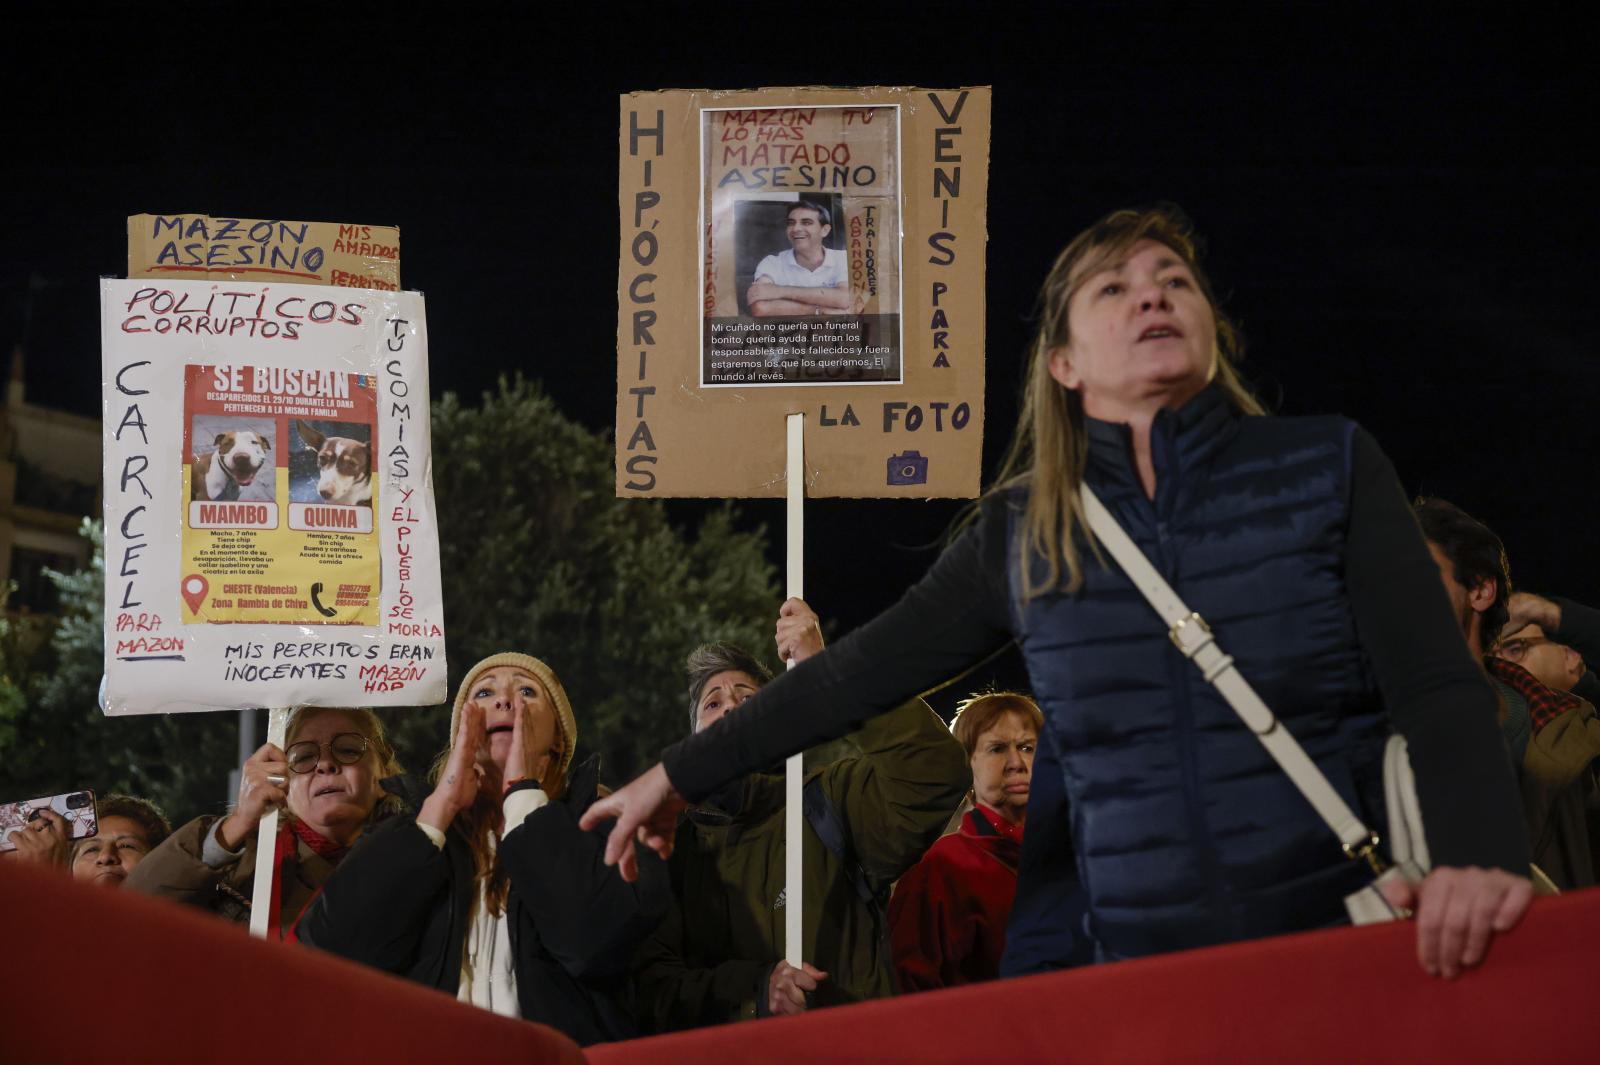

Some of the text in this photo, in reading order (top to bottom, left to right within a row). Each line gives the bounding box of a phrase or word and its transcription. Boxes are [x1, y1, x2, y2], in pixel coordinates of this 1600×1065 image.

[721, 126, 805, 142] LO HAS
[723, 143, 850, 166] MATADO
[717, 165, 876, 189] ASESINO
[928, 91, 969, 265] VENIS
[338, 224, 371, 241] MIS
[333, 239, 399, 259] AMADOS
[625, 110, 664, 491] HIPÓCRITAS
[121, 315, 304, 340] CORRUPTOS
[711, 323, 723, 332] Mi
[725, 323, 760, 332] cuñado
[778, 321, 808, 333] quería
[810, 323, 823, 331] un
[825, 321, 859, 330] funeral
[931, 282, 950, 367] PARA
[711, 335, 744, 345] bonito,
[746, 335, 776, 346] quería
[812, 333, 844, 342] Entran
[846, 333, 860, 342] los
[711, 345, 890, 359] responsables de los fallecidos y fuera
[711, 360, 762, 369] estaremos
[764, 359, 779, 368] los
[780, 359, 799, 369] que
[801, 358, 816, 367] los
[874, 357, 884, 366] El
[213, 364, 244, 393] SE
[252, 366, 350, 399] BUSCAN
[711, 371, 787, 381] mundo al revés.
[206, 391, 354, 409] DESAPARECIDOS EL 29/10 DURANTE LA DANA
[224, 403, 338, 417] PERTENECEN A LA MISMA FAMILIA
[820, 403, 860, 426] LA
[883, 402, 970, 432] FOTO
[116, 360, 162, 632] CARCEL PARA
[399, 488, 414, 503] Y
[200, 504, 268, 525] MAMBO
[304, 507, 358, 529] QUIMA
[391, 507, 419, 522] EL
[397, 526, 414, 607] PUEBLO
[223, 584, 298, 595] CHESTE (Valencia)
[211, 598, 233, 609] Zona
[271, 599, 283, 609] de
[284, 599, 308, 609] Chiva
[388, 606, 414, 620] SE
[116, 636, 184, 655] MAZON
[224, 641, 435, 661] MIS PERRITOS ERAN
[358, 661, 427, 682] MAZÓN
